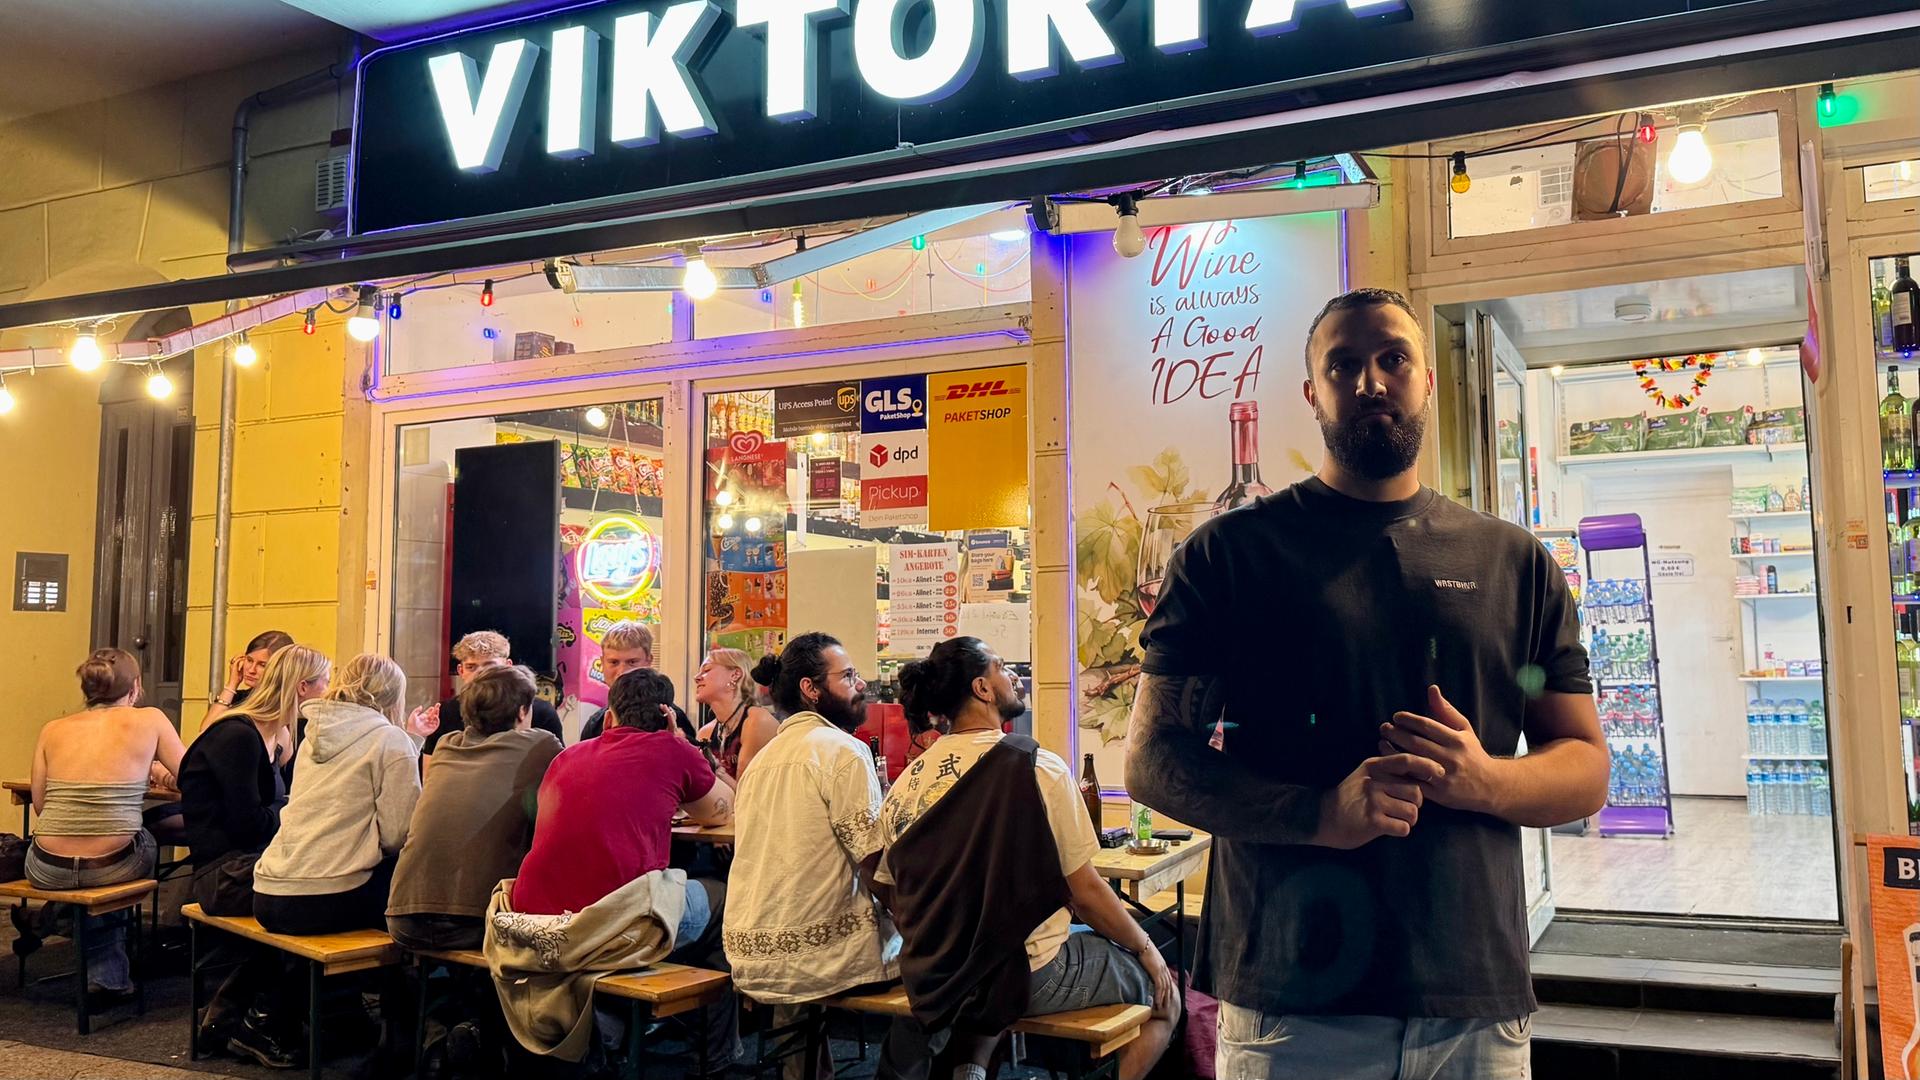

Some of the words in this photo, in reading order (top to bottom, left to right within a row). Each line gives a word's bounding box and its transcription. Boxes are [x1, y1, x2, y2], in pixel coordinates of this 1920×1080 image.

[1149, 222, 1261, 290] Wine
[1150, 297, 1167, 315] is
[1175, 283, 1261, 311] always
[1151, 316, 1174, 353] A
[1183, 316, 1262, 348] Good
[1151, 344, 1263, 405] IDEA
[865, 387, 912, 413] GLS
[945, 380, 1009, 401] DHL
[778, 402, 792, 410] UPS
[793, 399, 814, 409] Access
[839, 394, 856, 409] ups
[880, 412, 912, 421] PaketShop
[944, 407, 1012, 424] PAKETSHOP
[893, 445, 919, 464] dpd
[868, 484, 920, 504] Pickup
[899, 548, 949, 559] SIM-KARTEN
[904, 560, 945, 571] ANGEBOTE
[1896, 856, 1920, 882] B
